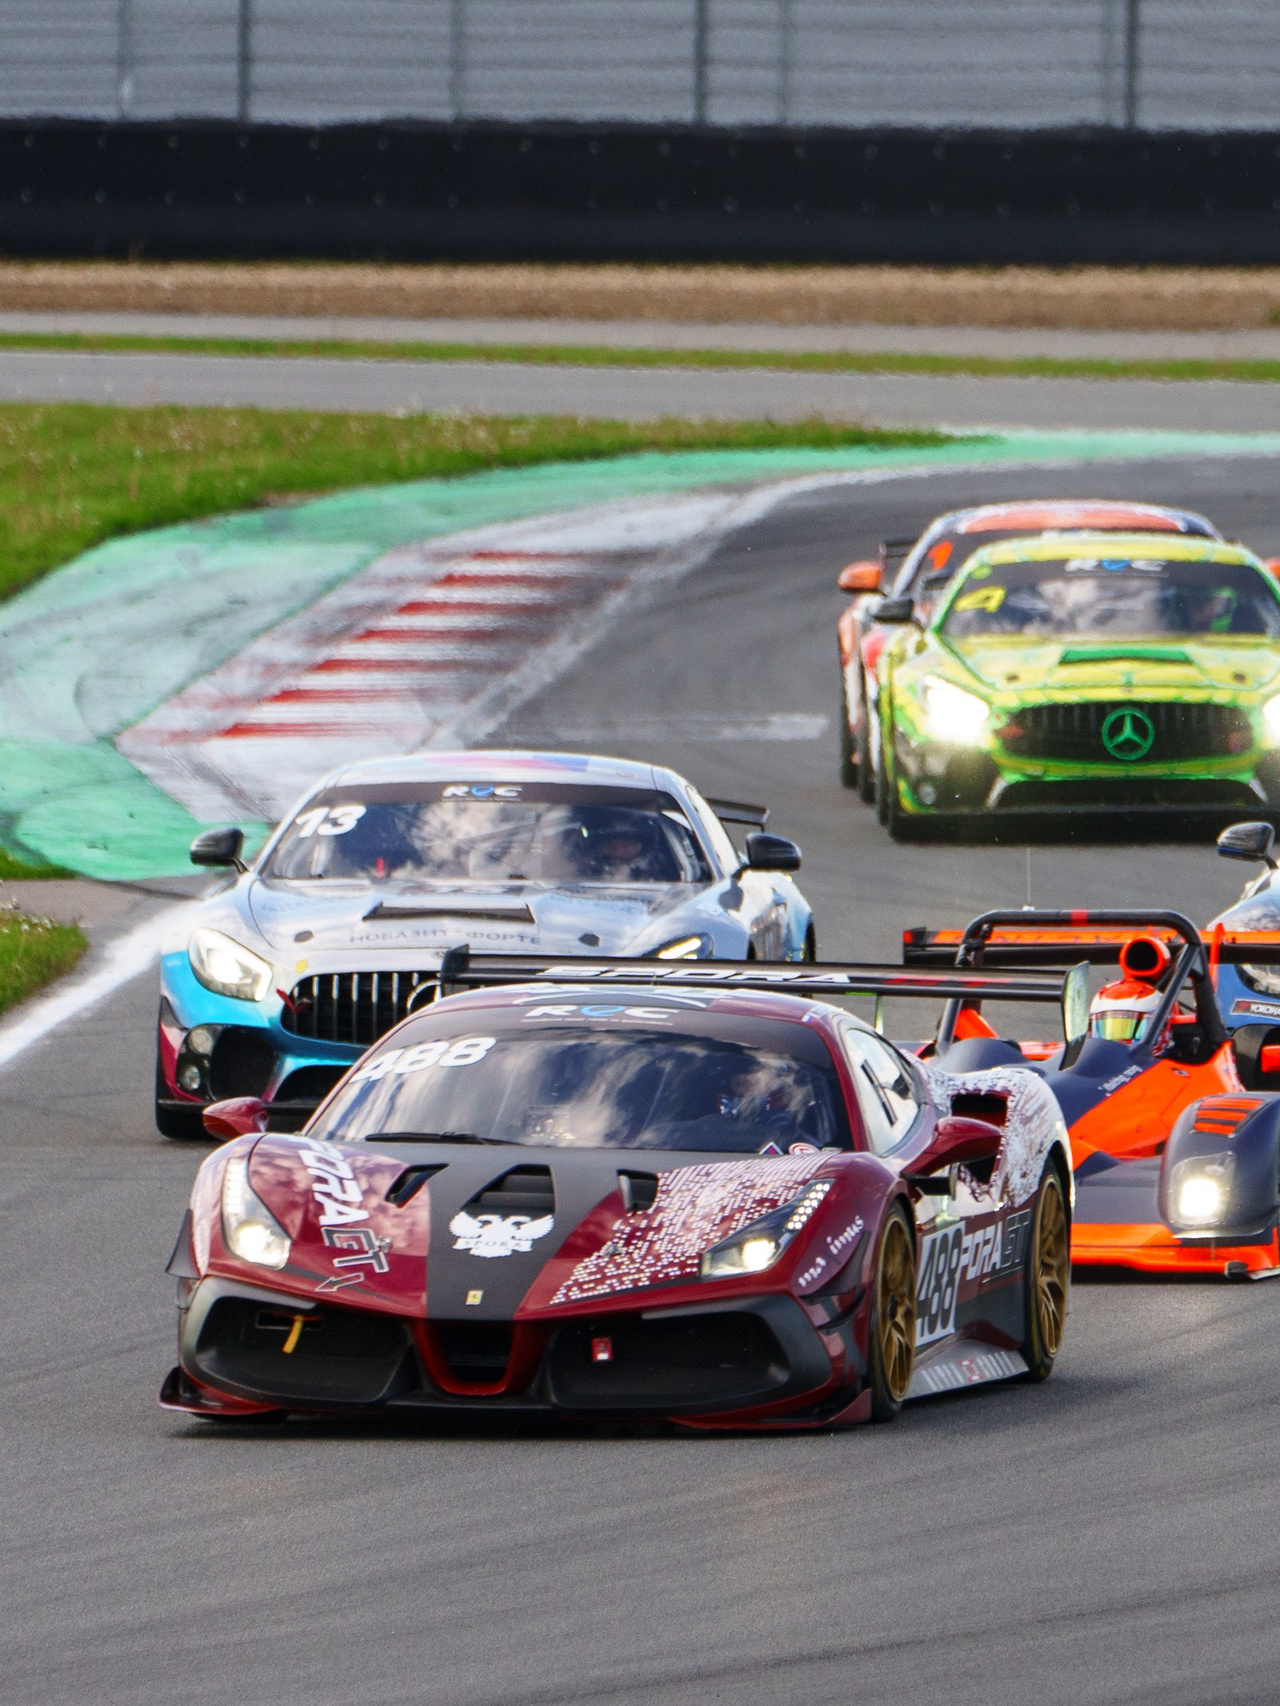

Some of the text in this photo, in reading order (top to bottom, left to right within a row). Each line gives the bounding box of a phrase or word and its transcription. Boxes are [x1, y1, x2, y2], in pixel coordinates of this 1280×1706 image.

[295, 804, 367, 838] 13
[534, 967, 852, 983] SPORA
[343, 1036, 497, 1084] 488
[916, 1227, 964, 1339] 488
